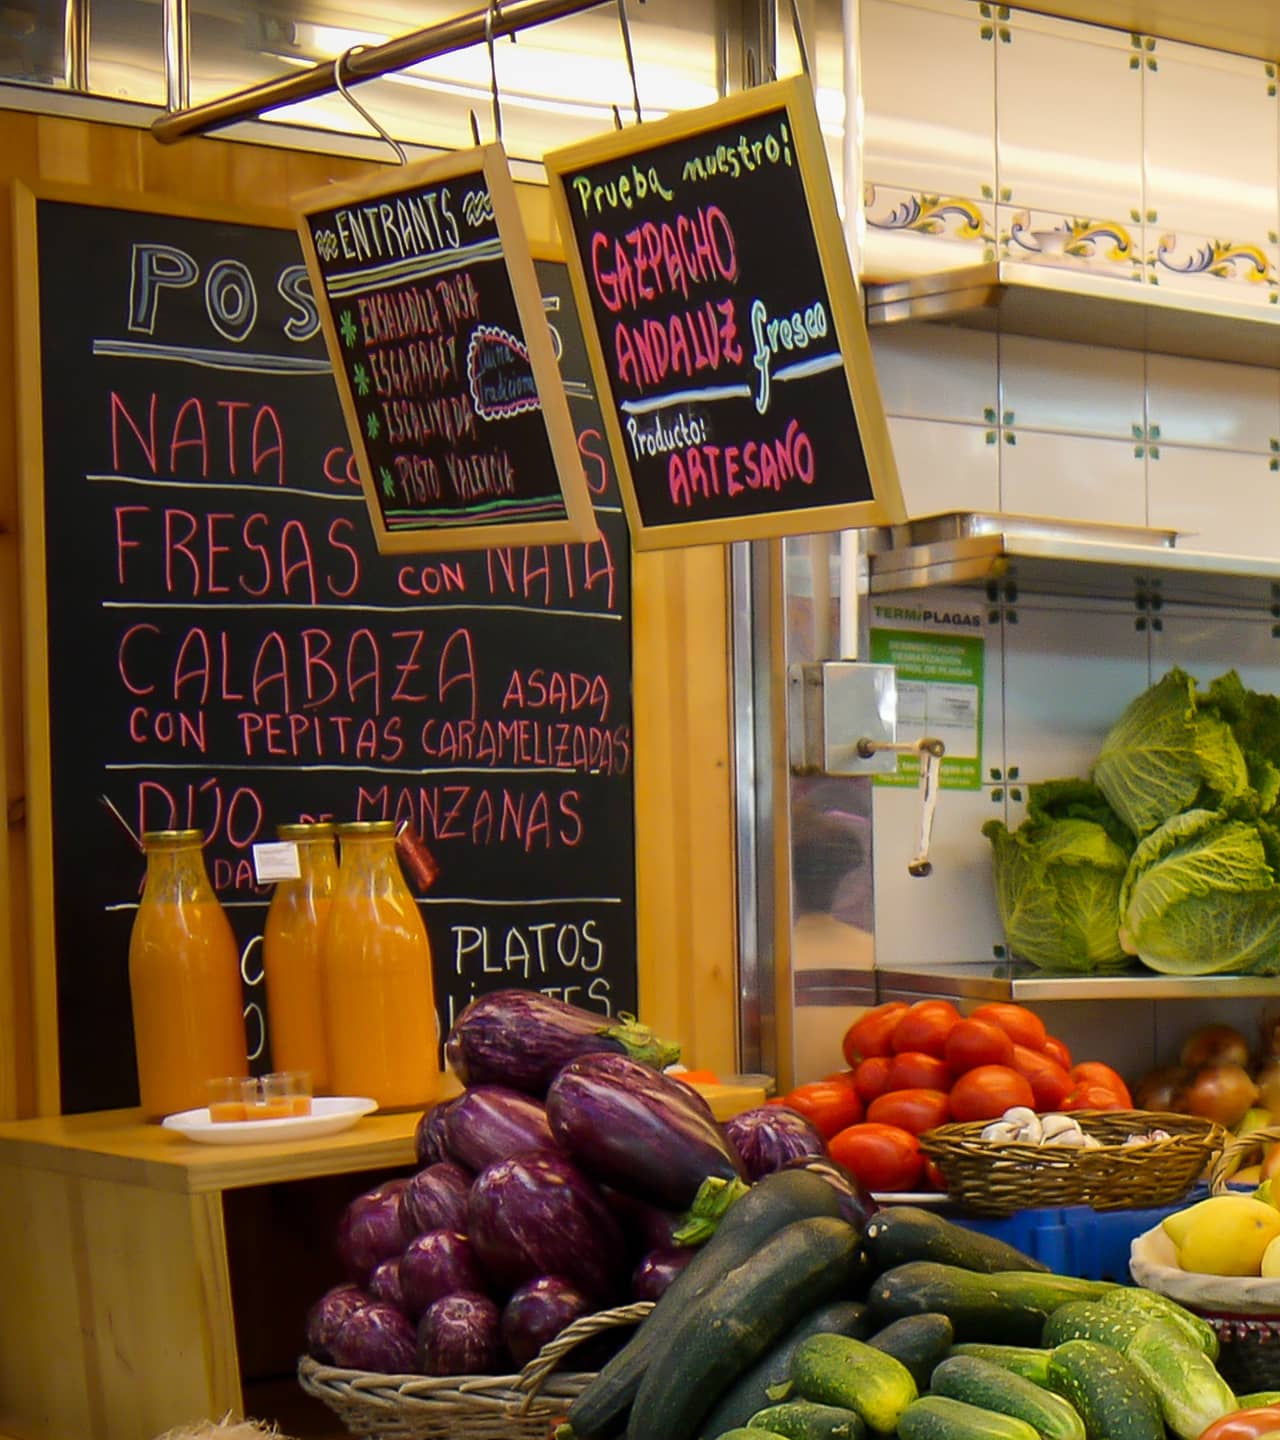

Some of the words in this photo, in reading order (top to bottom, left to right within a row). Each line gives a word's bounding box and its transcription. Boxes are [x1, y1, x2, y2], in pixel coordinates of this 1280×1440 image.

[335, 188, 460, 262] ENTRANTS
[573, 168, 674, 214] Prueba
[592, 204, 738, 312] GAZPACHO
[614, 298, 744, 393] ANDALUZ
[750, 298, 829, 416] fresco
[110, 391, 286, 486] NATA
[668, 418, 816, 507] ARTESANO
[114, 506, 360, 606] FRESAS
[118, 622, 479, 720] CALABAZA
[502, 668, 611, 723] ASADA
[129, 706, 207, 754] CON
[421, 718, 632, 776] CARAMELIZADAS
[356, 784, 586, 852] MANZANAS
[450, 919, 605, 979] PLATOS
